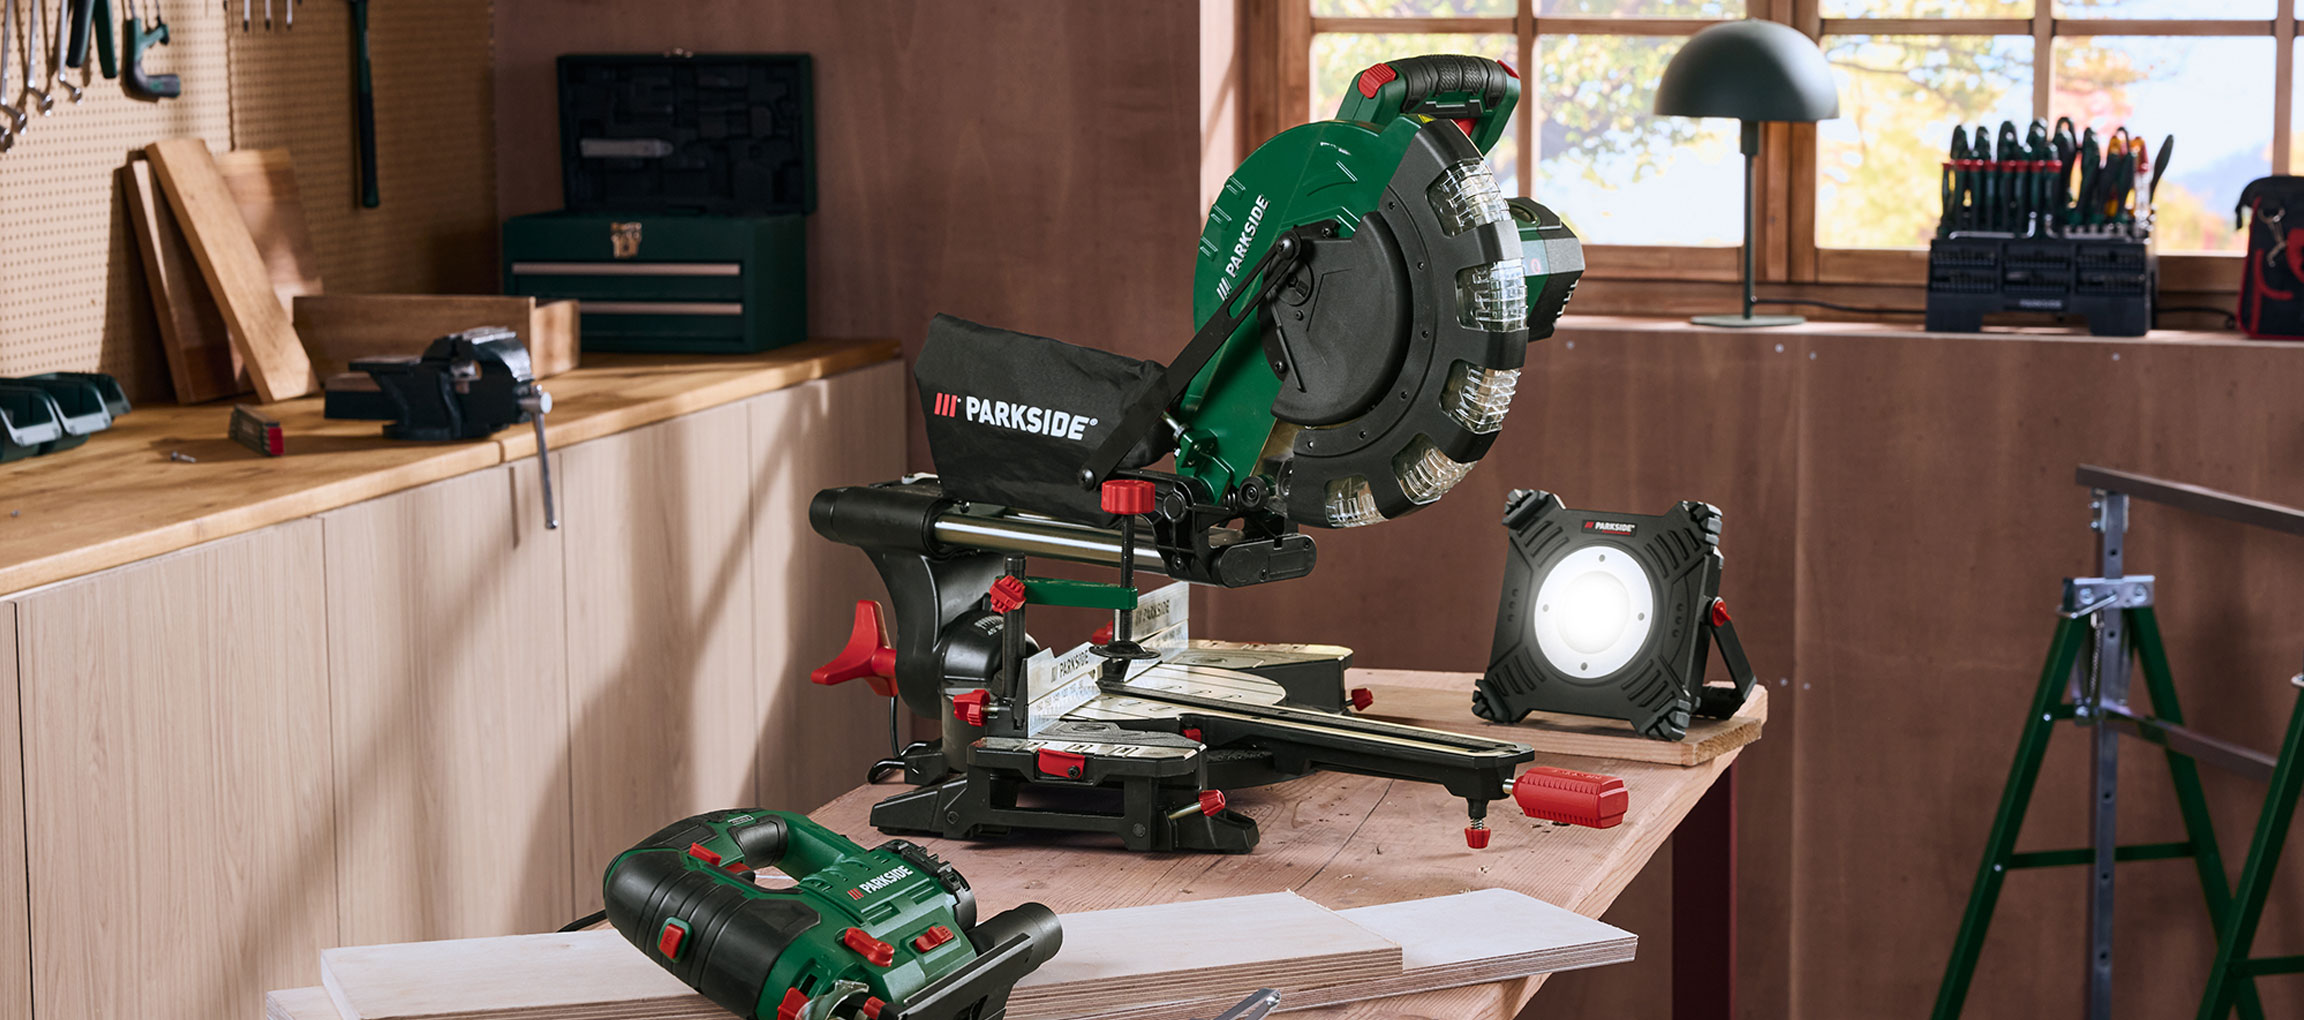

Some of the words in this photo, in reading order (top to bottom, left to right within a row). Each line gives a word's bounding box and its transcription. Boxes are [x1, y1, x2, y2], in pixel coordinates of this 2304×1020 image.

[1225, 194, 1269, 278] PARKSIDE
[1060, 649, 1089, 678] PARKSIDE
[859, 865, 913, 894] PARKSIDE
